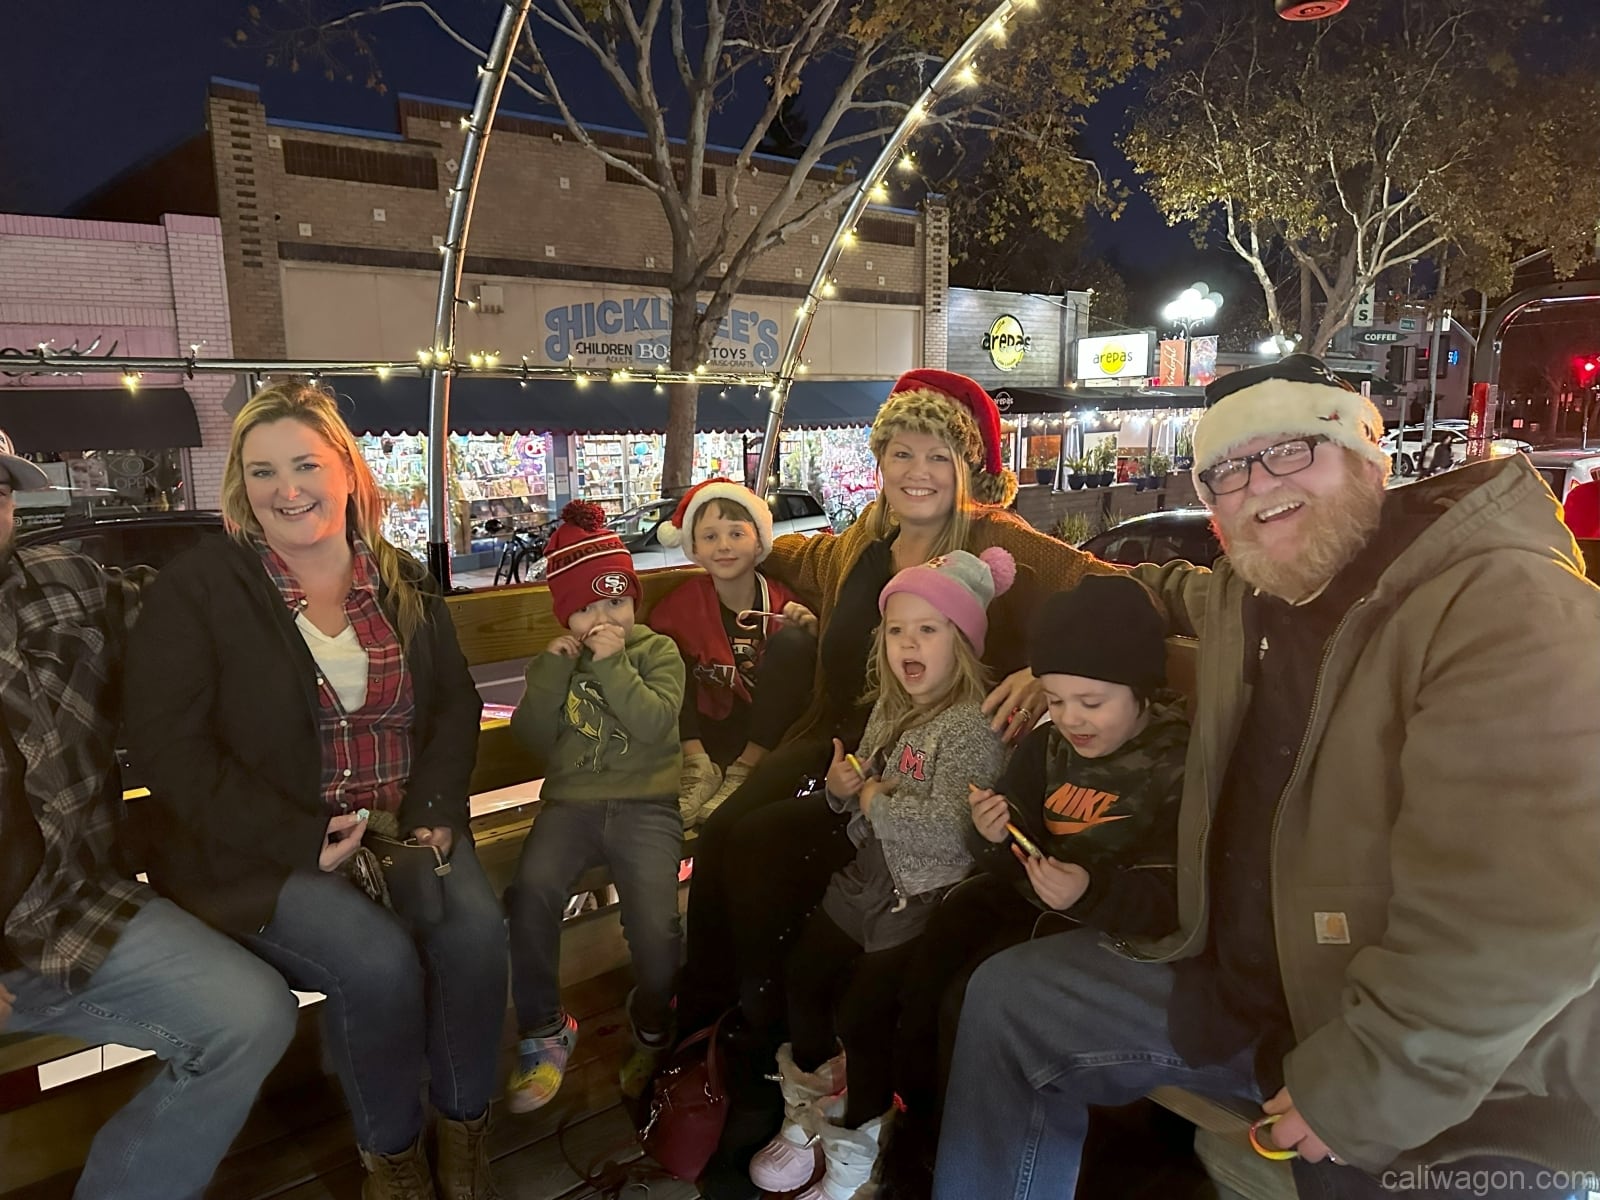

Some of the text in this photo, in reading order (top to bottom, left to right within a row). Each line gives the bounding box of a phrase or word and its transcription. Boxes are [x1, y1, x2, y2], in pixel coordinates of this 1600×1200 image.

[545, 297, 779, 367] HICKLE'S
[1364, 333, 1398, 341] COFFEE
[576, 341, 747, 360] CHILDREN BO TOYS
[982, 332, 1031, 352] arepas
[1092, 351, 1133, 364] arepas
[114, 476, 159, 489] OPEN
[899, 744, 926, 781] M
[1044, 782, 1120, 823] NIKE
